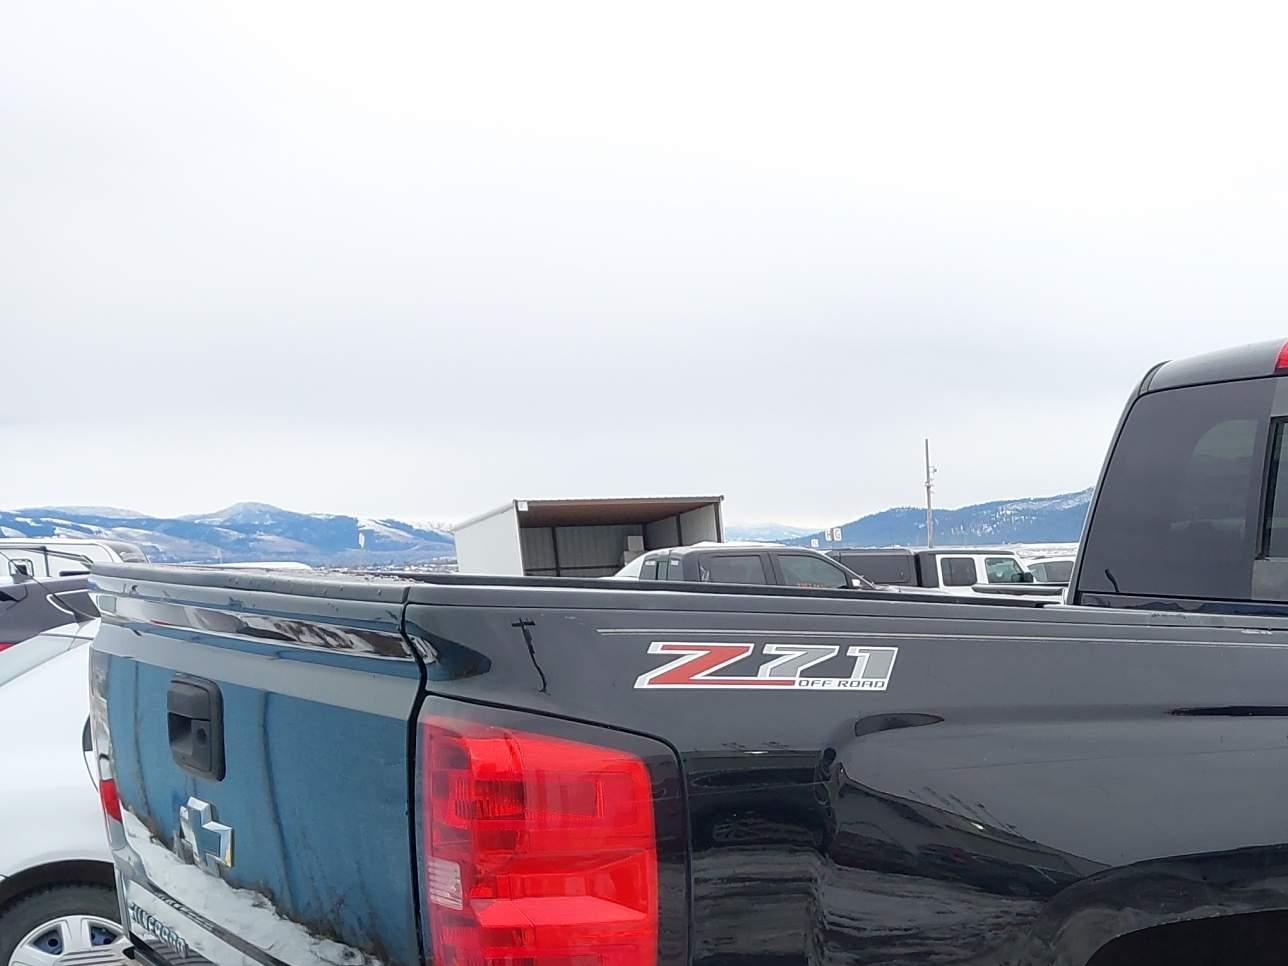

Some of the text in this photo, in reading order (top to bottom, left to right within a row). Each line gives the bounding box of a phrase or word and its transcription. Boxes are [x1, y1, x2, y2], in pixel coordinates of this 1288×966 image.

[633, 641, 898, 690] Z71
[798, 679, 886, 688] OFF ROAD
